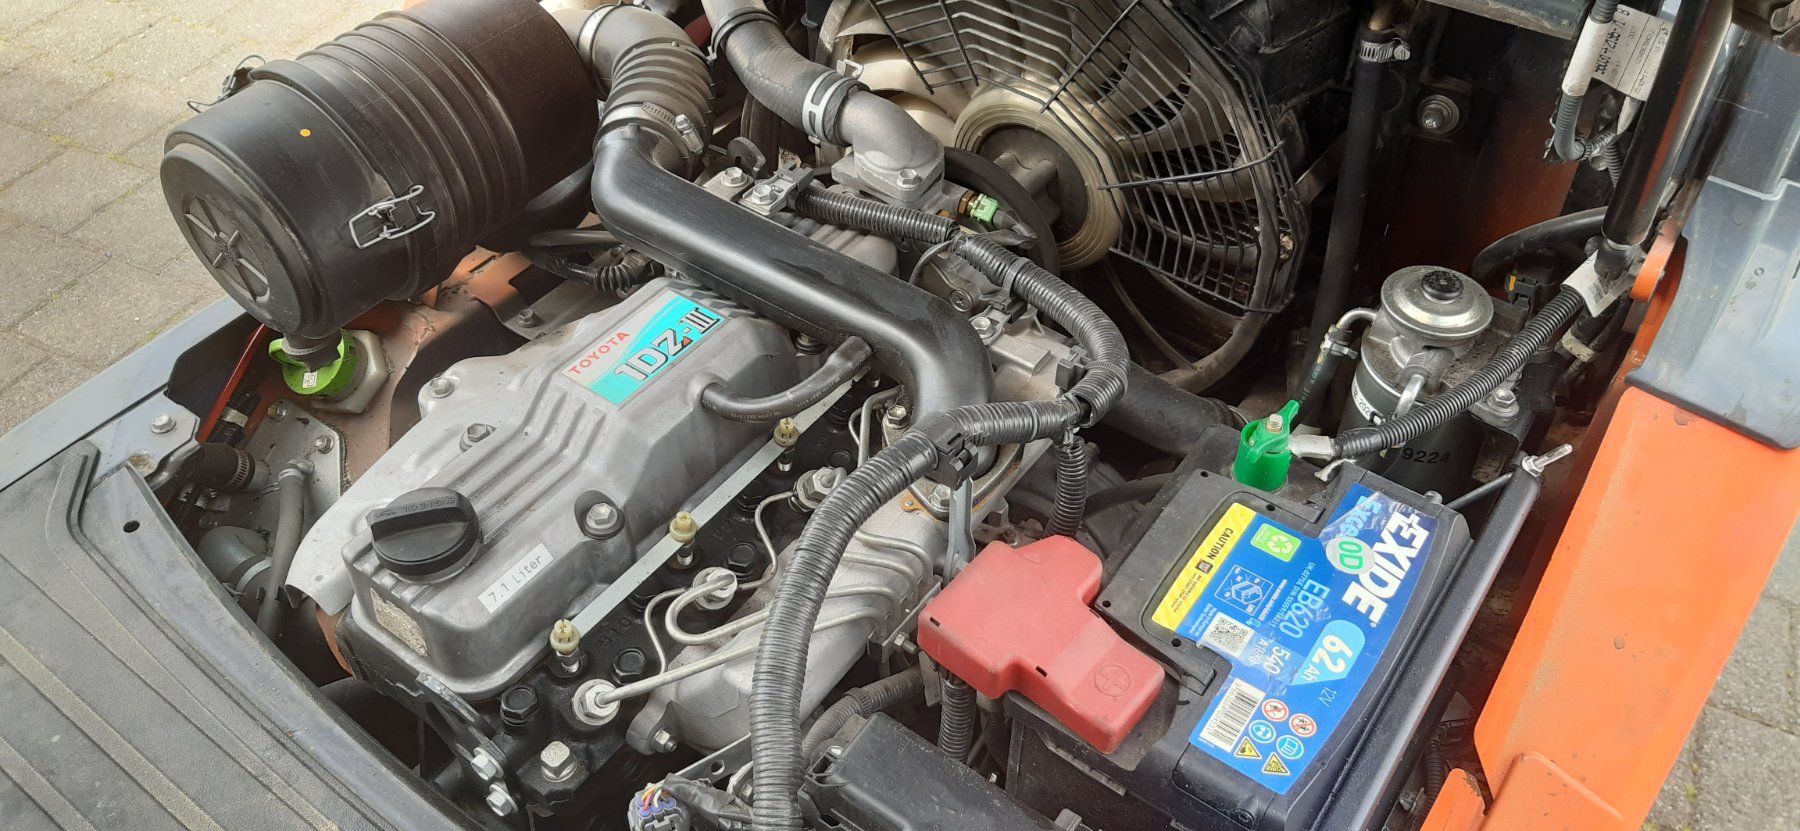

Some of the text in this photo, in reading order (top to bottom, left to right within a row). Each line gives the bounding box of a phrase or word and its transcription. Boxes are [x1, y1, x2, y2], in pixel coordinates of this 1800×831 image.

[568, 331, 631, 375] TOYOTA
[614, 307, 721, 382] 1DZ-III
[403, 497, 456, 513] ENGINE OIL
[1206, 526, 1233, 560] CAUTION
[488, 555, 542, 603] 7.1 Liter
[1341, 510, 1429, 625] EXIDE
[1277, 578, 1330, 640] EB620
[1260, 646, 1291, 676] 540
[1300, 634, 1353, 682] 62 Ah
[1317, 686, 1337, 707] 12V
